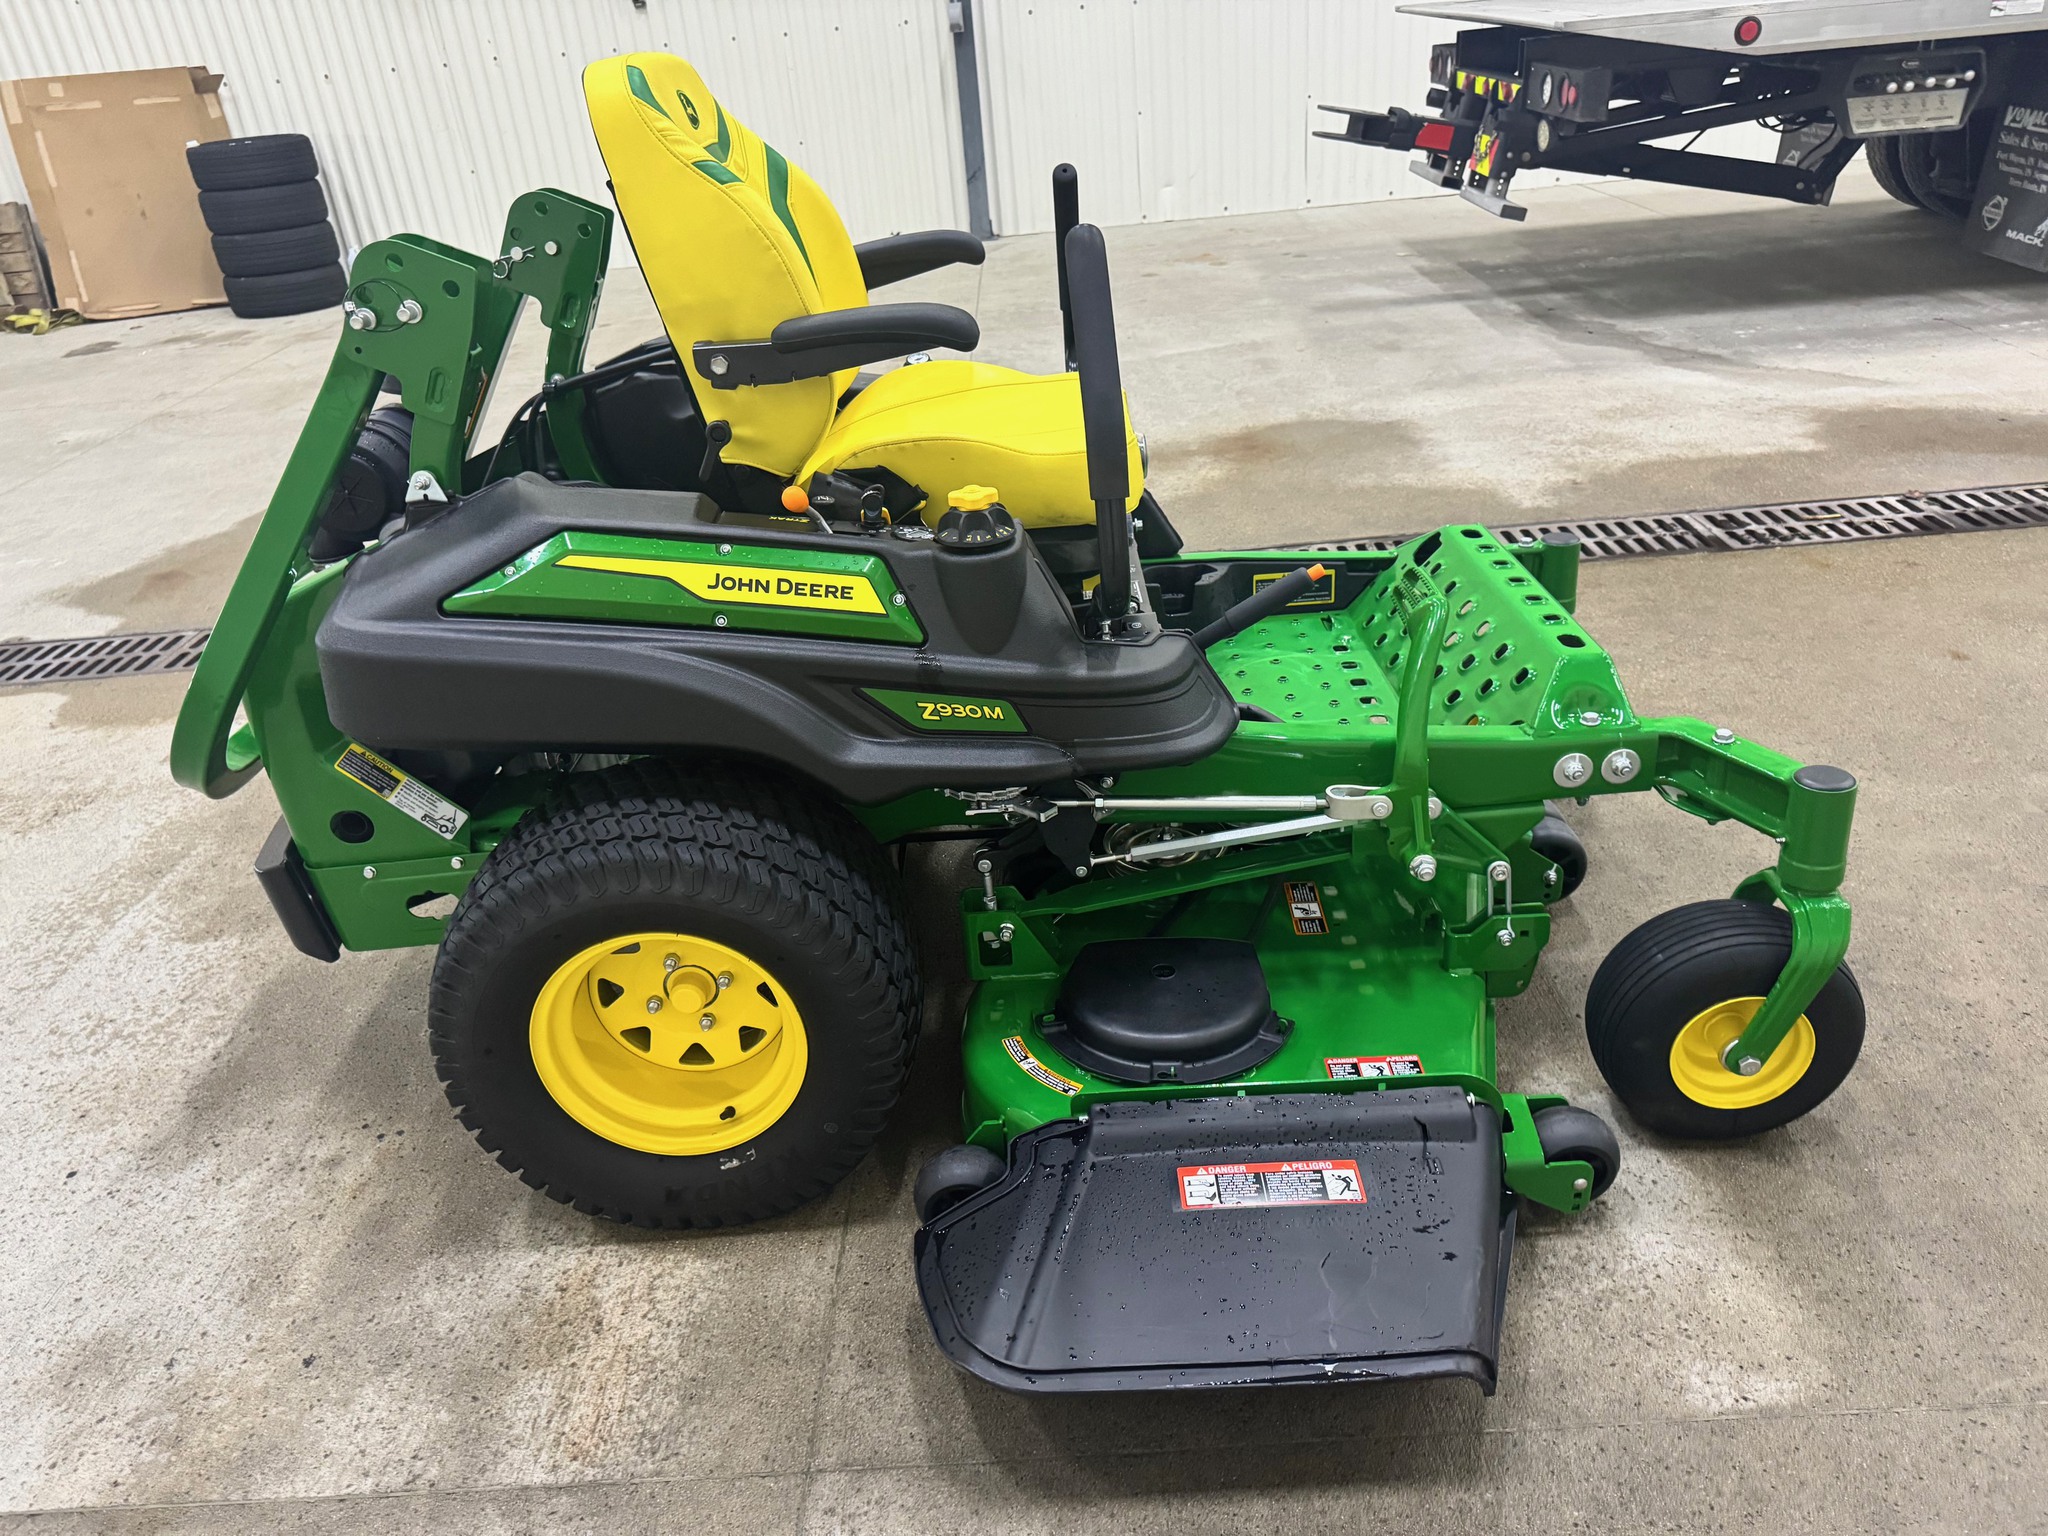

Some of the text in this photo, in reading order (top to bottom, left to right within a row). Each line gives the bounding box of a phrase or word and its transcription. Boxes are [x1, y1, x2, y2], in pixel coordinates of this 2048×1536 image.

[2006, 228, 2043, 247] MACK
[707, 573, 854, 600] JOHN DEERE
[916, 702, 1004, 720] Z930M
[366, 753, 393, 773] CAUTION
[1208, 1165, 1247, 1174] DANGER
[1292, 1161, 1333, 1171] PELIGRO
